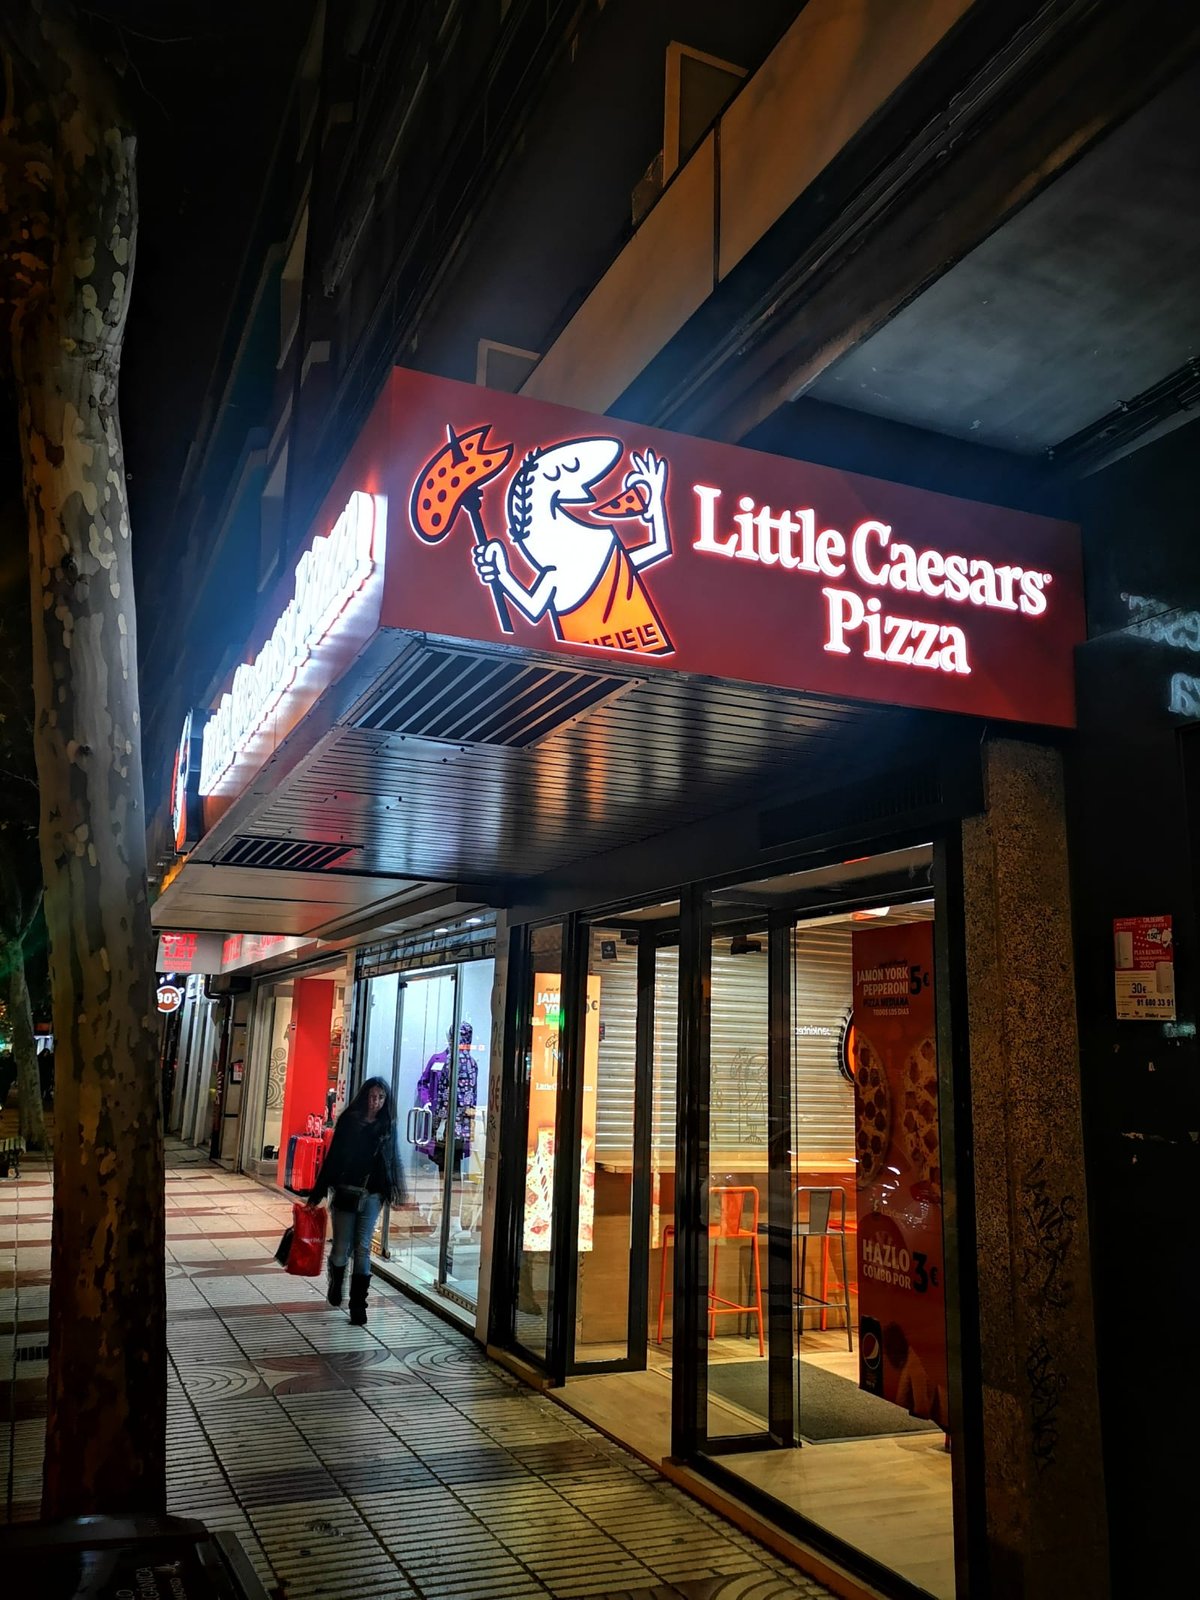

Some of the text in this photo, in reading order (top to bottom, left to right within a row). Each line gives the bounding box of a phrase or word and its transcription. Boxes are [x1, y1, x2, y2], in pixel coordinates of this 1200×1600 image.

[693, 484, 848, 577] Little
[822, 587, 971, 675] Pizza
[885, 966, 909, 980] YORK
[536, 992, 560, 1006] JAM
[863, 981, 909, 996] PEPPERONI
[862, 1238, 910, 1272] HAZLO
[863, 1264, 912, 1290] COMBO POR
